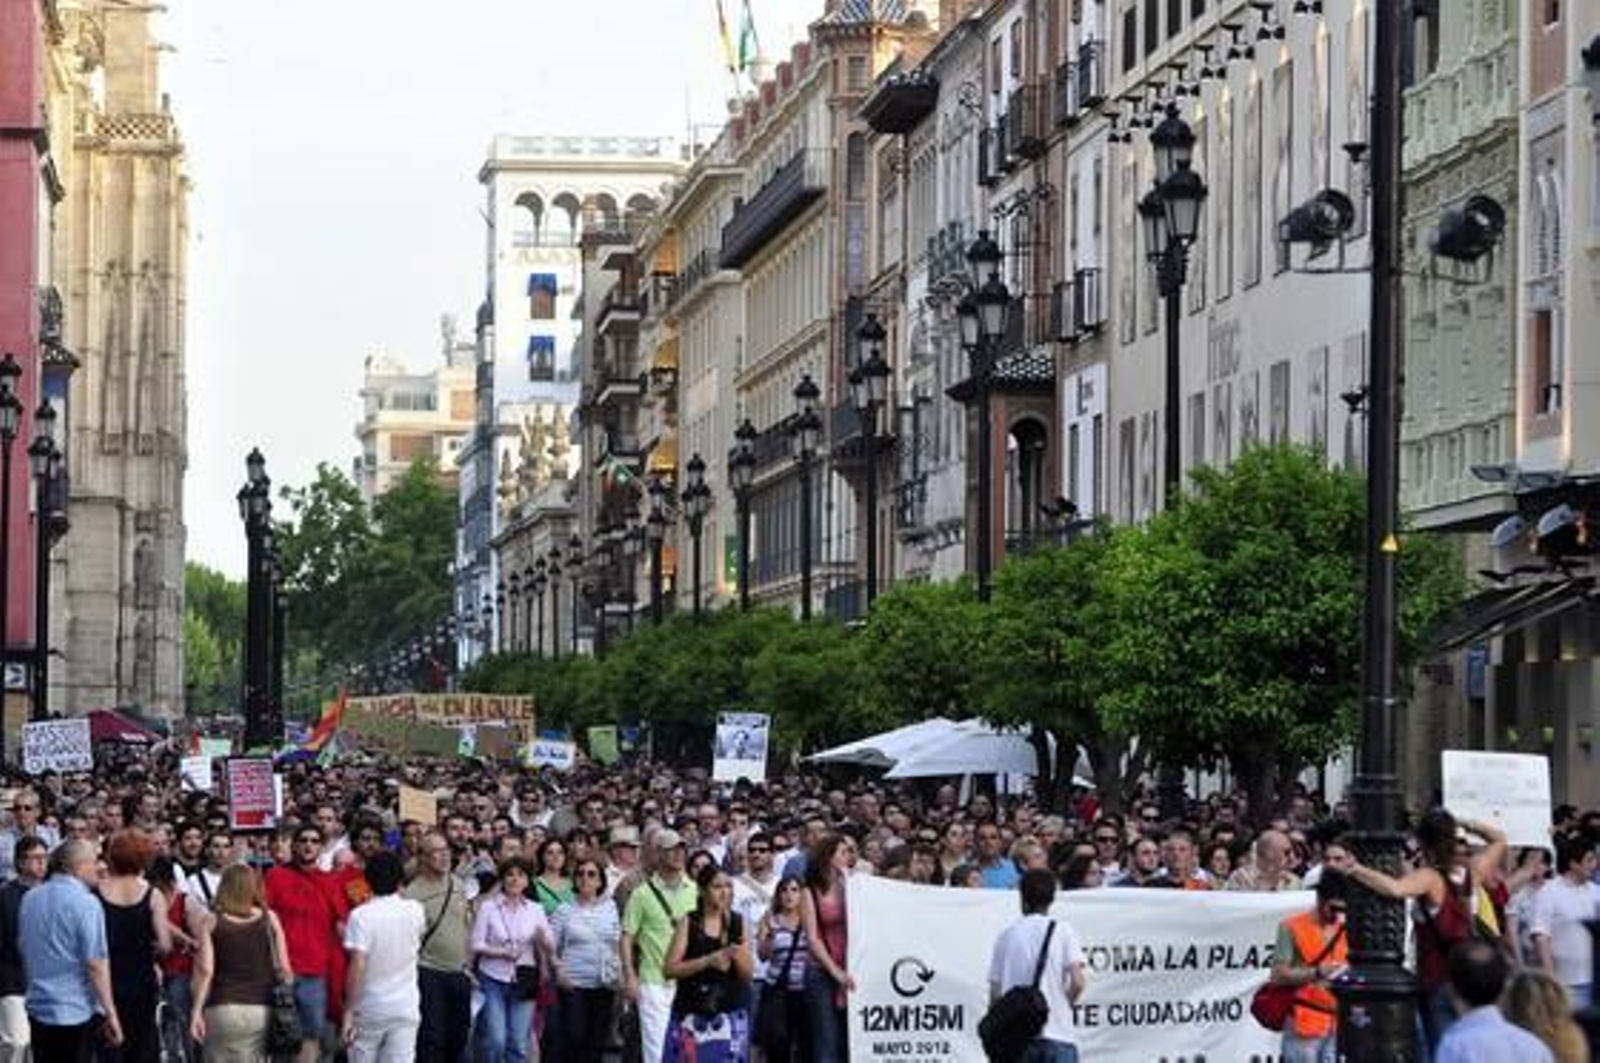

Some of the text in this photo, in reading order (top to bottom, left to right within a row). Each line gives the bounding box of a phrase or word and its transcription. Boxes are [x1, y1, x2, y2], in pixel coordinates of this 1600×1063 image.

[1082, 944, 1155, 972] OMA
[1164, 944, 1198, 970] LA
[859, 1004, 963, 1032] 12M15M
[1106, 998, 1243, 1026] CIUDADANO
[873, 1041, 951, 1055] MAYO 2012
